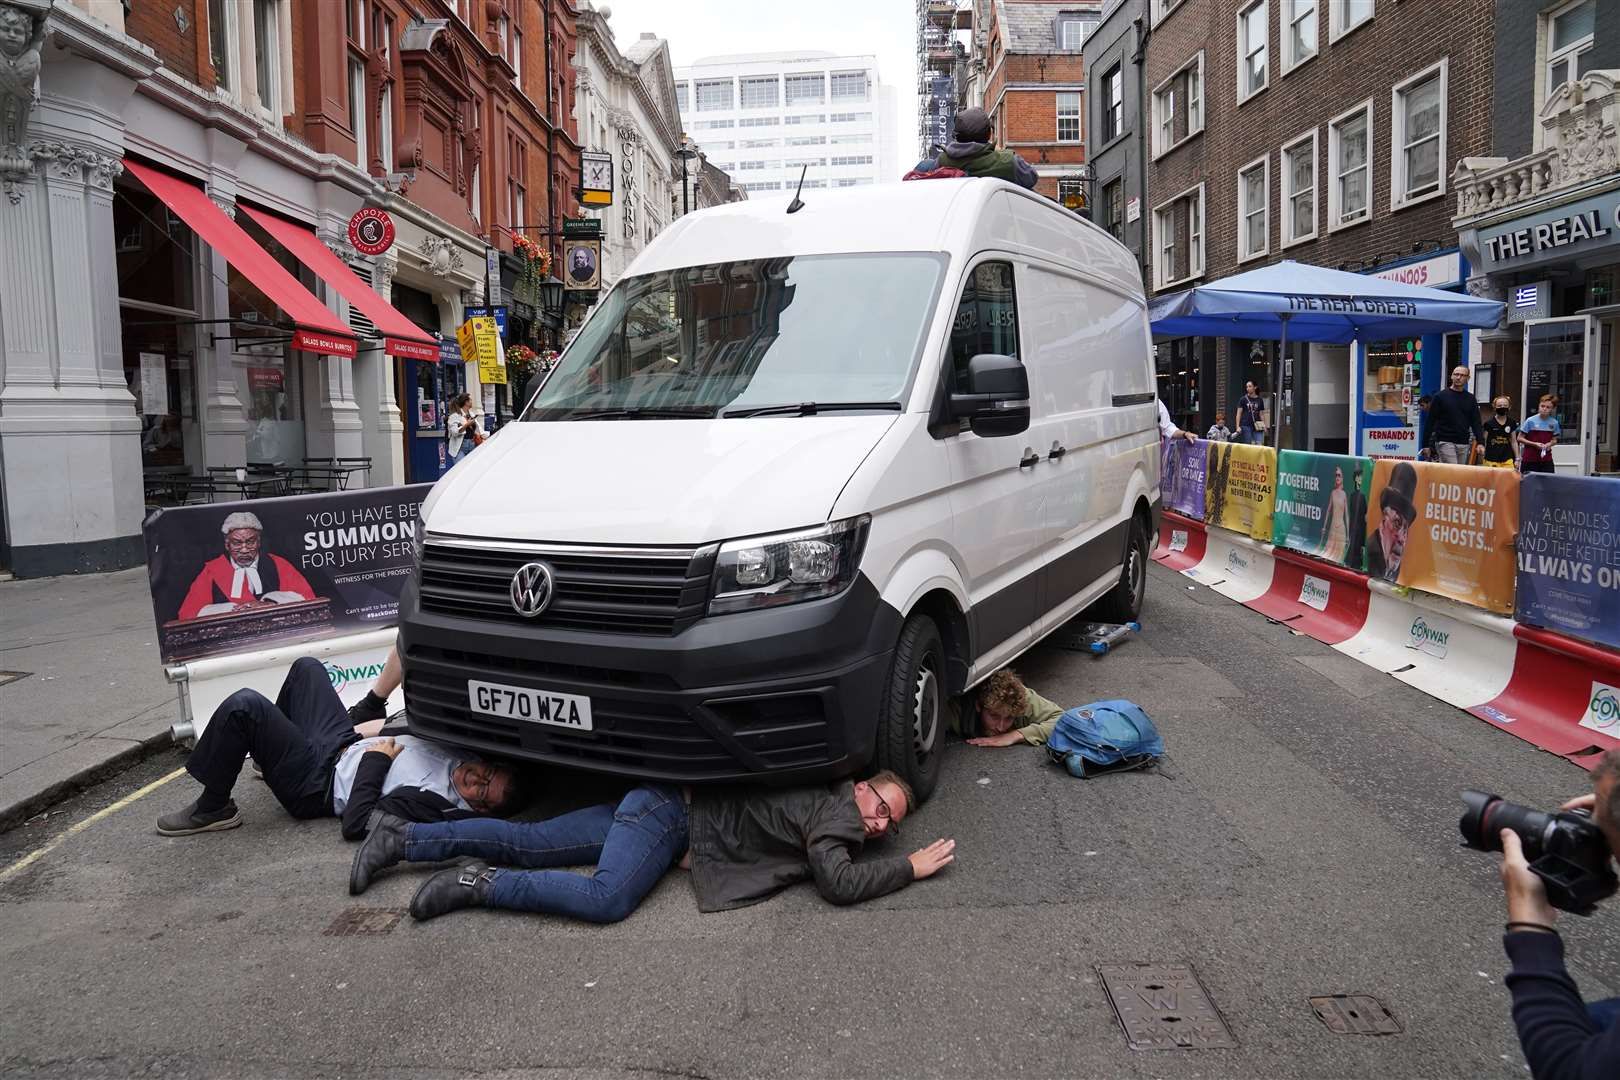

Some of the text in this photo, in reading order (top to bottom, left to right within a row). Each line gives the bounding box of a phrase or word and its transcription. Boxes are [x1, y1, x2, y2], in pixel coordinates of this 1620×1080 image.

[621, 142, 634, 238] COWARD
[350, 209, 391, 228] CHIPOTLE
[1485, 229, 1530, 261] THE
[1535, 211, 1607, 250] REAL
[1284, 296, 1417, 315] THE REAL GREEK
[303, 336, 352, 352] SALADS BOWLS BURRITOS
[1369, 430, 1415, 440] FERNANDO'S
[1280, 472, 1320, 491] TOGETHER
[1439, 484, 1461, 501] DID
[1466, 486, 1496, 507] NOT
[352, 505, 393, 523] HAVE
[1275, 499, 1321, 520] UNLIMITED
[1425, 502, 1494, 529] BELIEVE IN
[1554, 508, 1609, 530] CANDLE'S
[304, 520, 415, 550] SUMMON
[1544, 522, 1565, 540] THE
[302, 551, 336, 569] FOR
[340, 545, 377, 568] JURY
[1552, 540, 1573, 557] THE
[1576, 544, 1620, 567] KETTLE
[334, 567, 412, 585] WITNESS FOR THE PROSEC
[345, 607, 361, 615] Can't
[361, 605, 372, 613] wait
[1411, 624, 1450, 645] CONWAY
[329, 663, 386, 683] ONWAY
[477, 686, 581, 726] GF70 WZA
